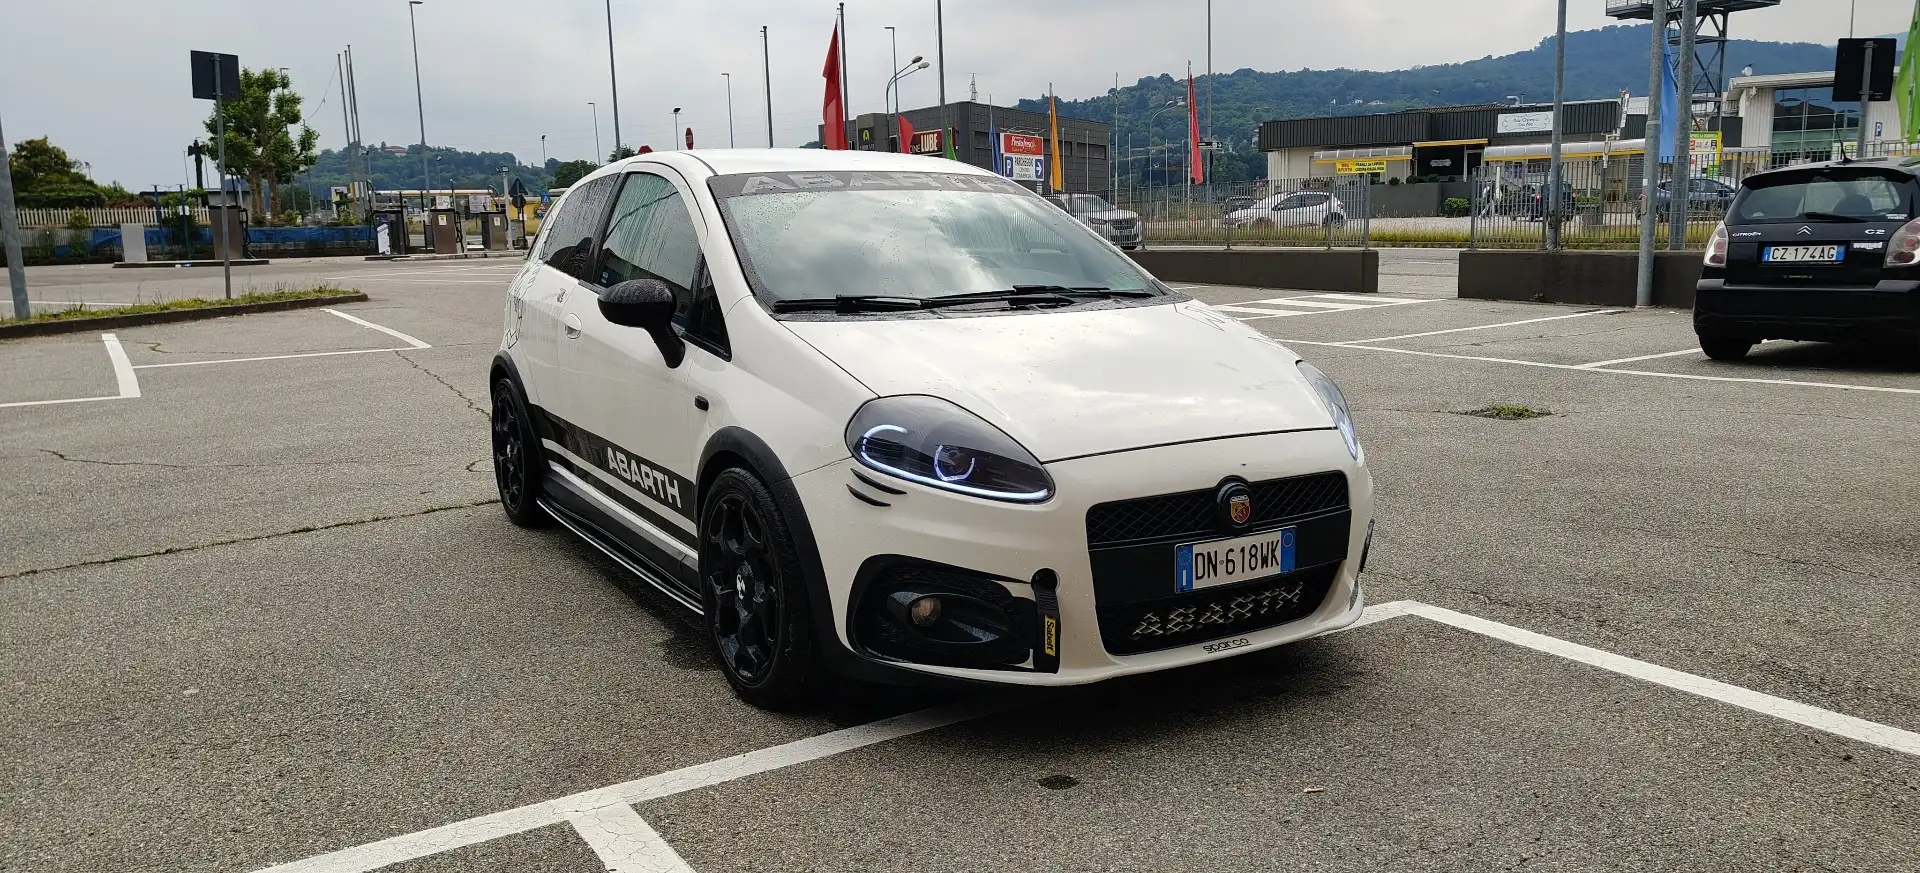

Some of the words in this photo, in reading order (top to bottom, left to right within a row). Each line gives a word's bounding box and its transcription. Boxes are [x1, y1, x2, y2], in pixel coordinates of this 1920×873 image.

[921, 133, 938, 152] LUBE
[741, 171, 1018, 195] ABARTH
[607, 446, 682, 509] ABARTH
[1046, 620, 1055, 651] Sabelt
[1202, 637, 1251, 653] sparco
